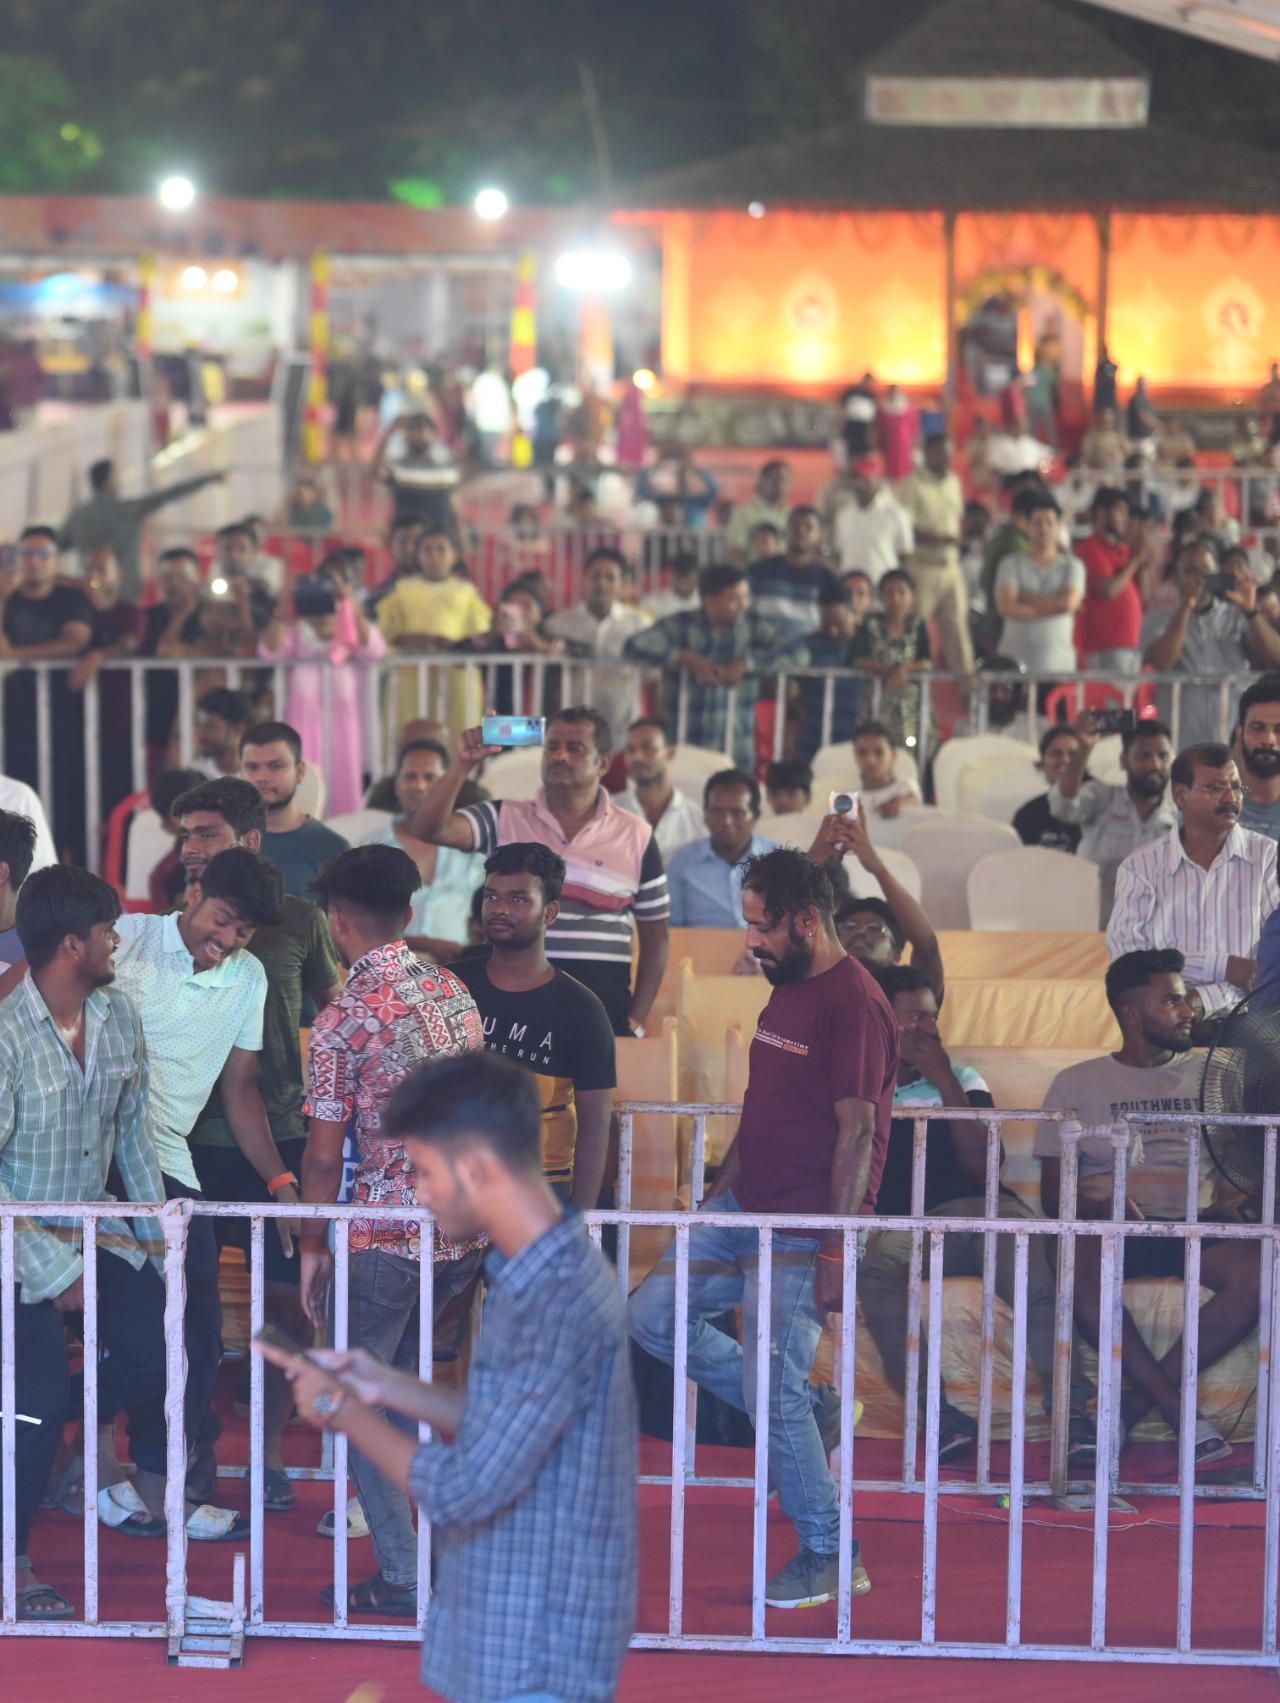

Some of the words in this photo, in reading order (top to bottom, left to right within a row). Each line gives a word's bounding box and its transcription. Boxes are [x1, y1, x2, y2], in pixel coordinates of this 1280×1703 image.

[482, 1016, 552, 1051] UMA
[517, 1049, 550, 1065] RUN
[1110, 1098, 1201, 1113] SOUTHWEST
